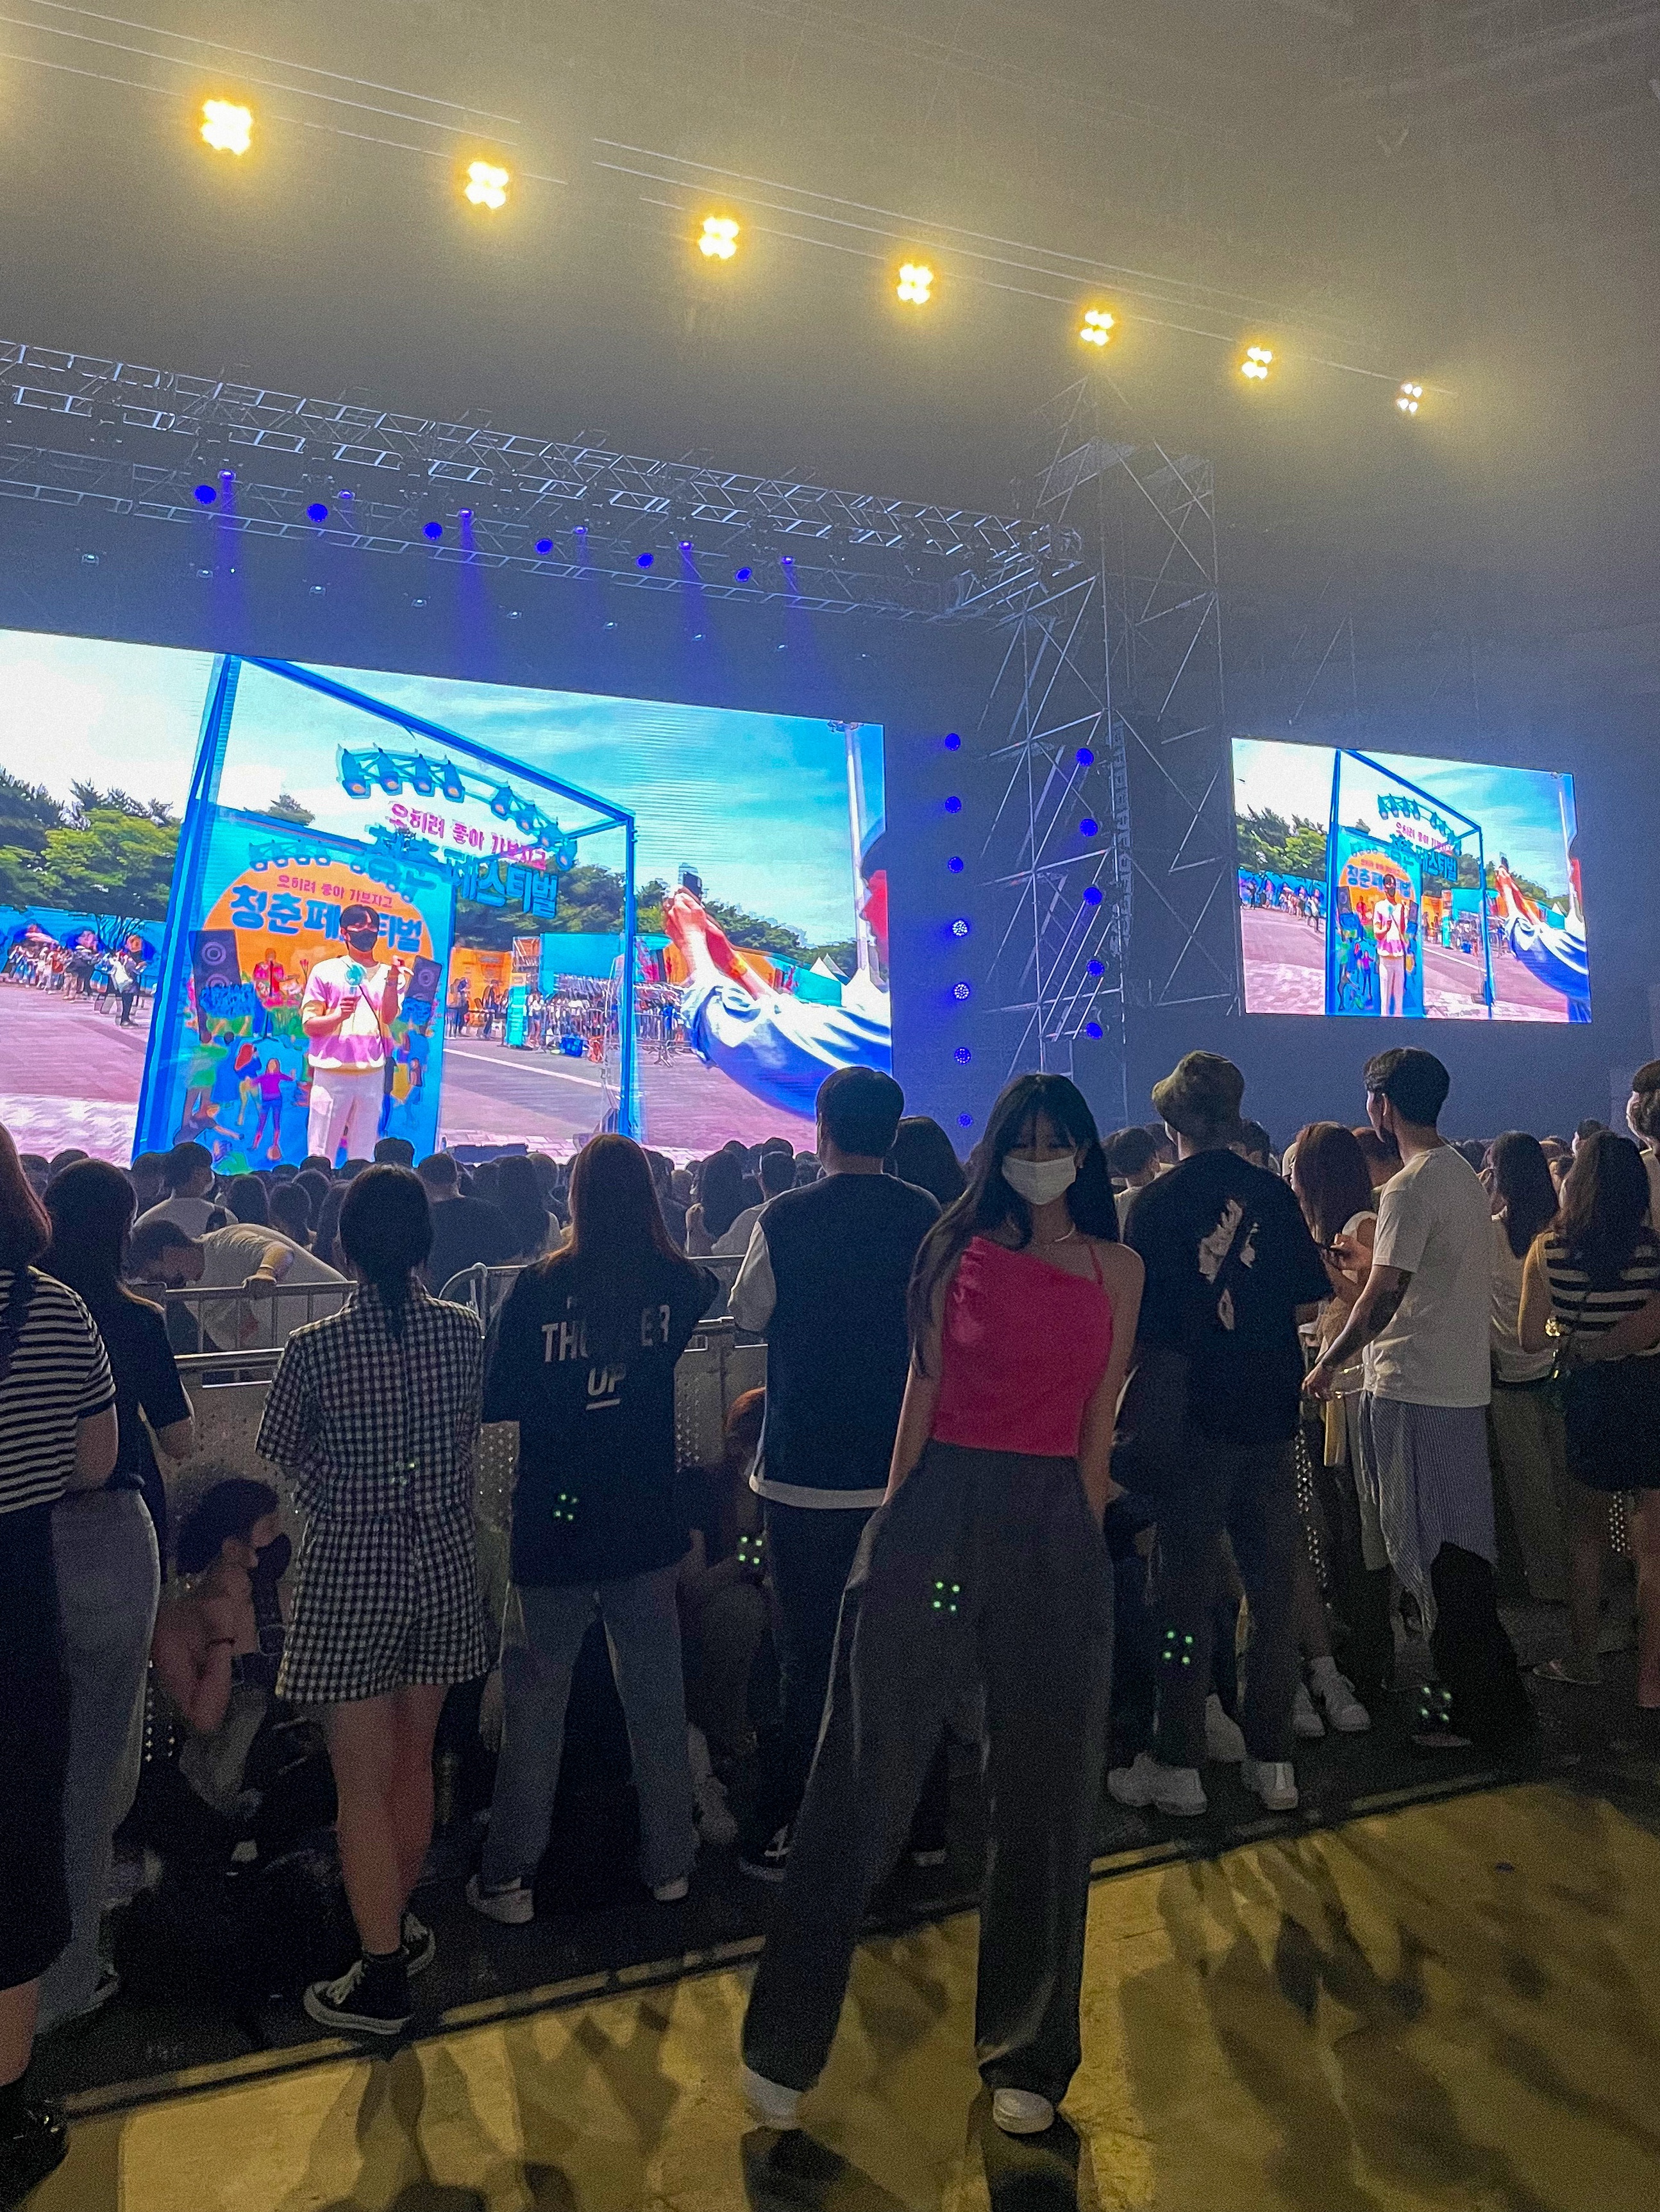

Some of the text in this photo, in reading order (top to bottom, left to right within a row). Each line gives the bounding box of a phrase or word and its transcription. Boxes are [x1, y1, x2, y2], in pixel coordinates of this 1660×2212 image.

[451, 821, 484, 851] 좋아
[230, 885, 422, 953] 청춘페티벌
[587, 1362, 627, 1396] UP
